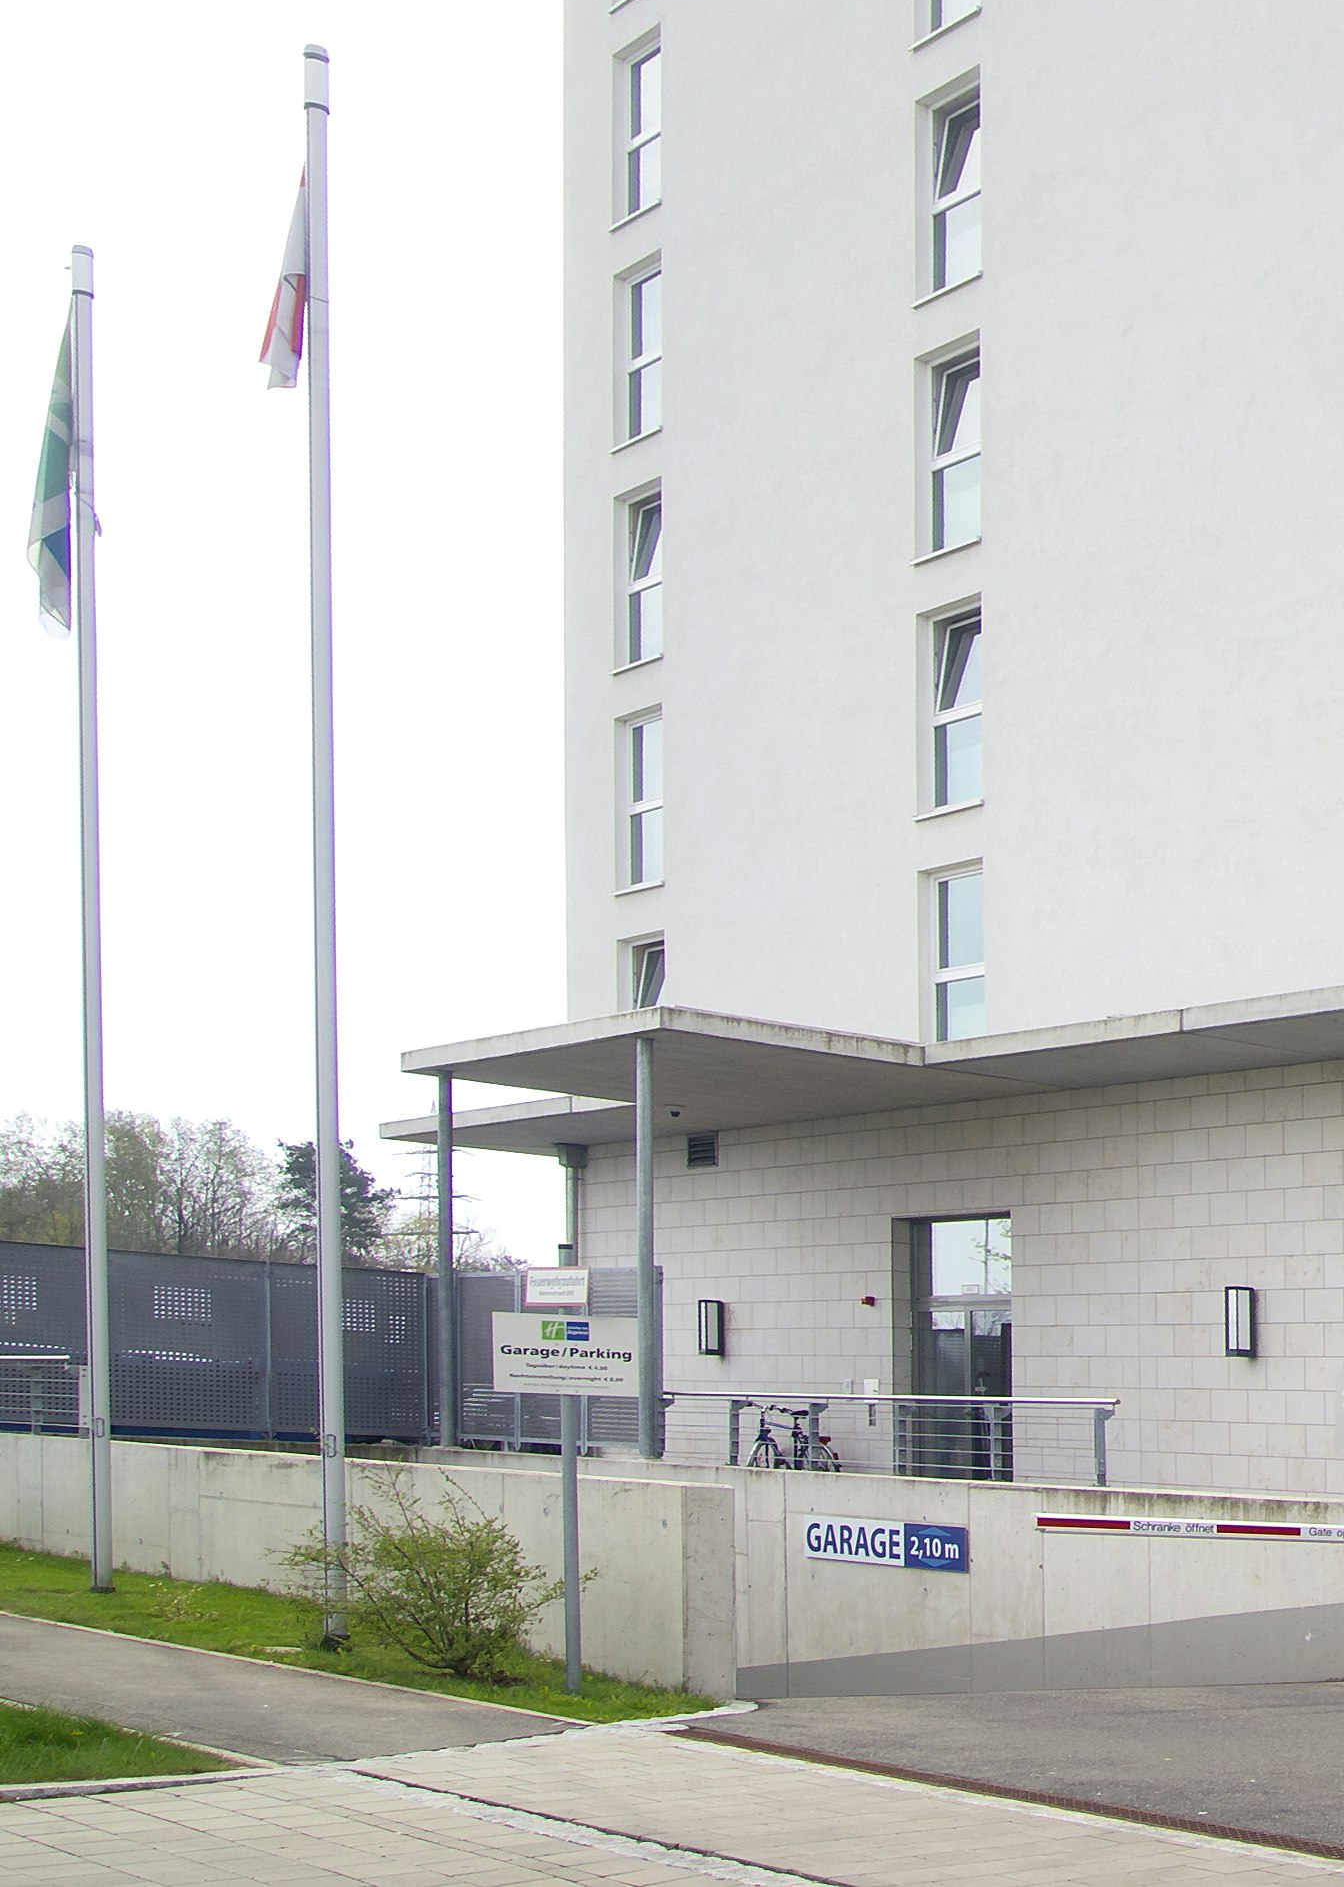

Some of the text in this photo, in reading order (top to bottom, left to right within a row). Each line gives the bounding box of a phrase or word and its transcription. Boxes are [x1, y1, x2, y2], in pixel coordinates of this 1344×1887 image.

[806, 1522, 960, 1559] GARAGE 2,10 m
[1132, 1520, 1182, 1533] Schranke
[1185, 1521, 1215, 1534] öffnet
[1308, 1527, 1333, 1537] Gate
